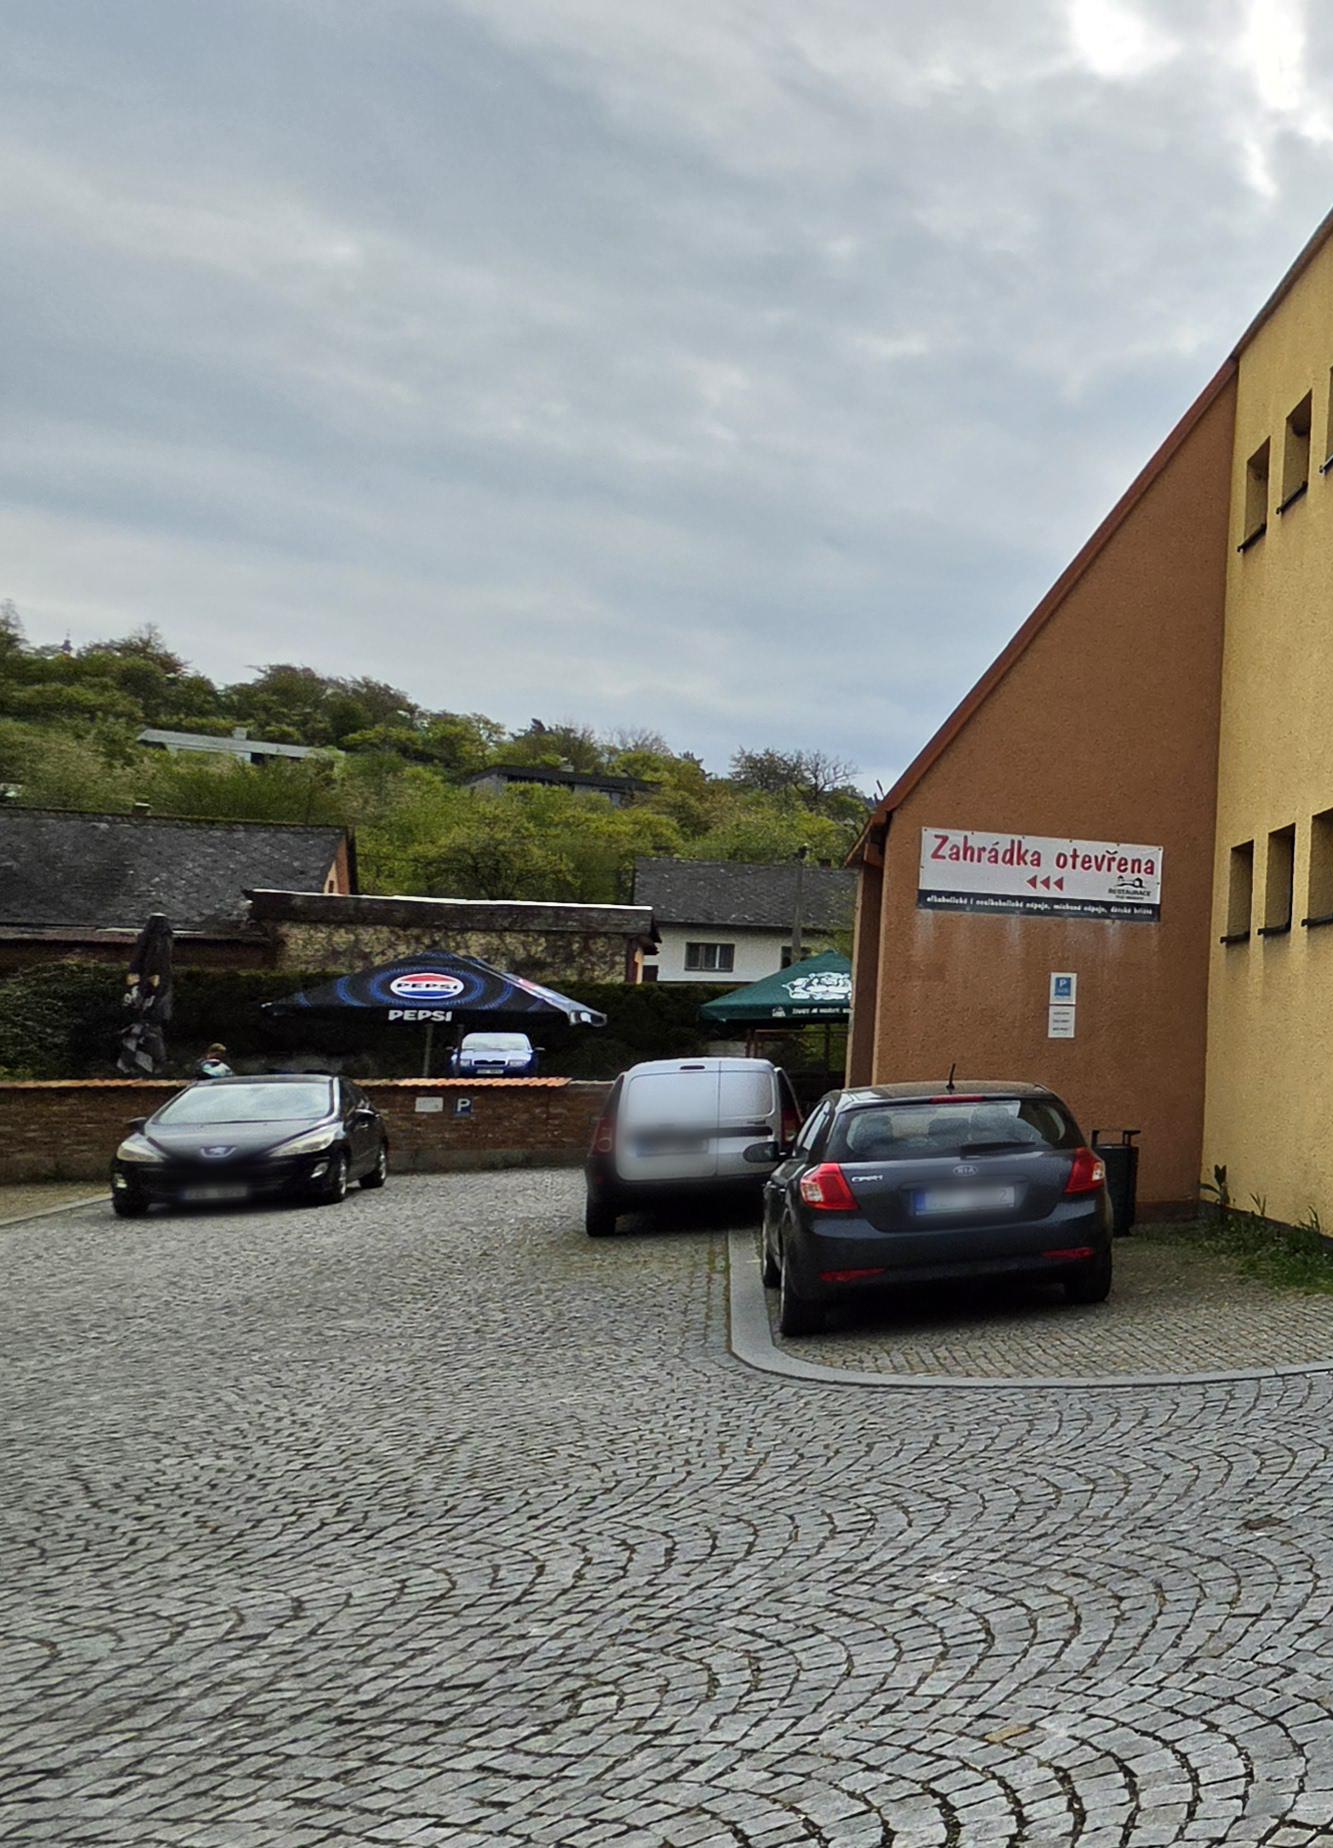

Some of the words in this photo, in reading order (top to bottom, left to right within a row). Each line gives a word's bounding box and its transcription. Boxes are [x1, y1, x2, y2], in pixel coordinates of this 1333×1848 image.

[931, 834, 1041, 868] Zahrádka
[1056, 850, 1155, 876] otevřena
[388, 1009, 453, 1022] PEPSI
[457, 1098, 471, 1113] P
